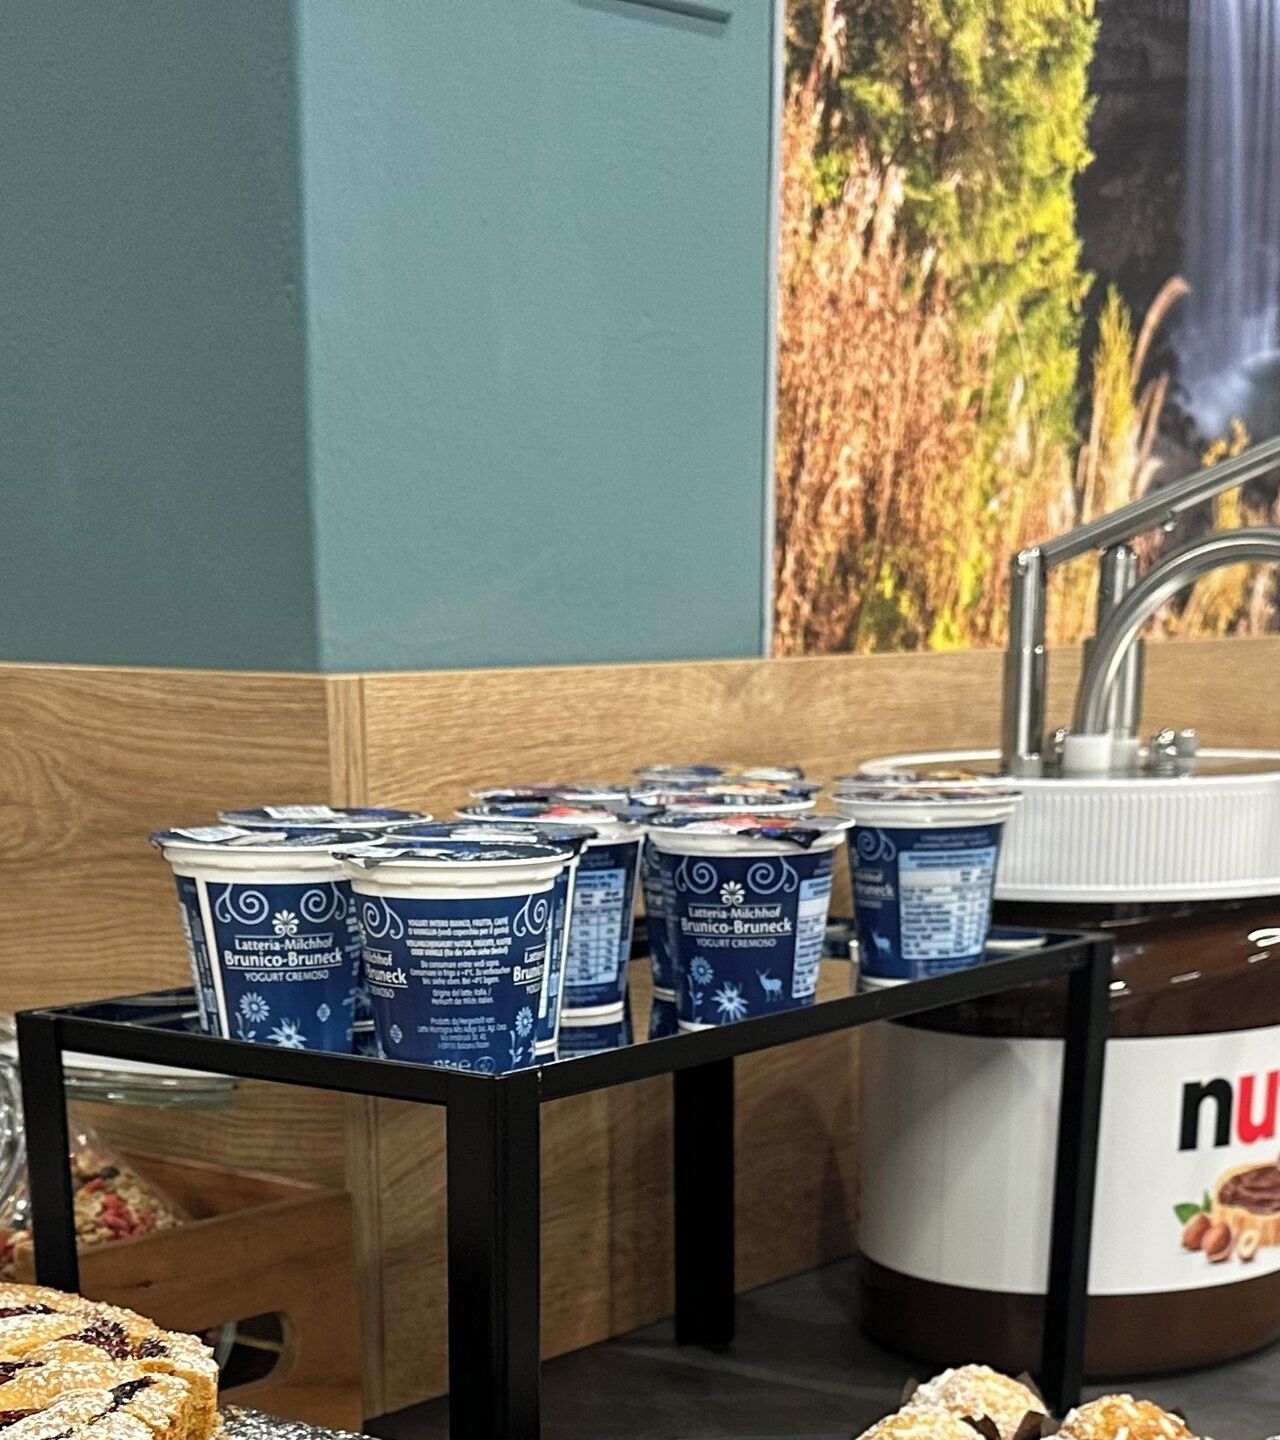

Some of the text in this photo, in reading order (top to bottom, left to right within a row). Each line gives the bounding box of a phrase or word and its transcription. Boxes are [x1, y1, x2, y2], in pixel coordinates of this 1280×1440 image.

[681, 917, 792, 934] Brunico-Bruneck
[234, 937, 333, 950] Latteria-Milchhof
[696, 938, 730, 948] YOGURT
[224, 948, 342, 967] Brunico-Bruneck
[244, 970, 329, 982] YOGURT CREMOSO
